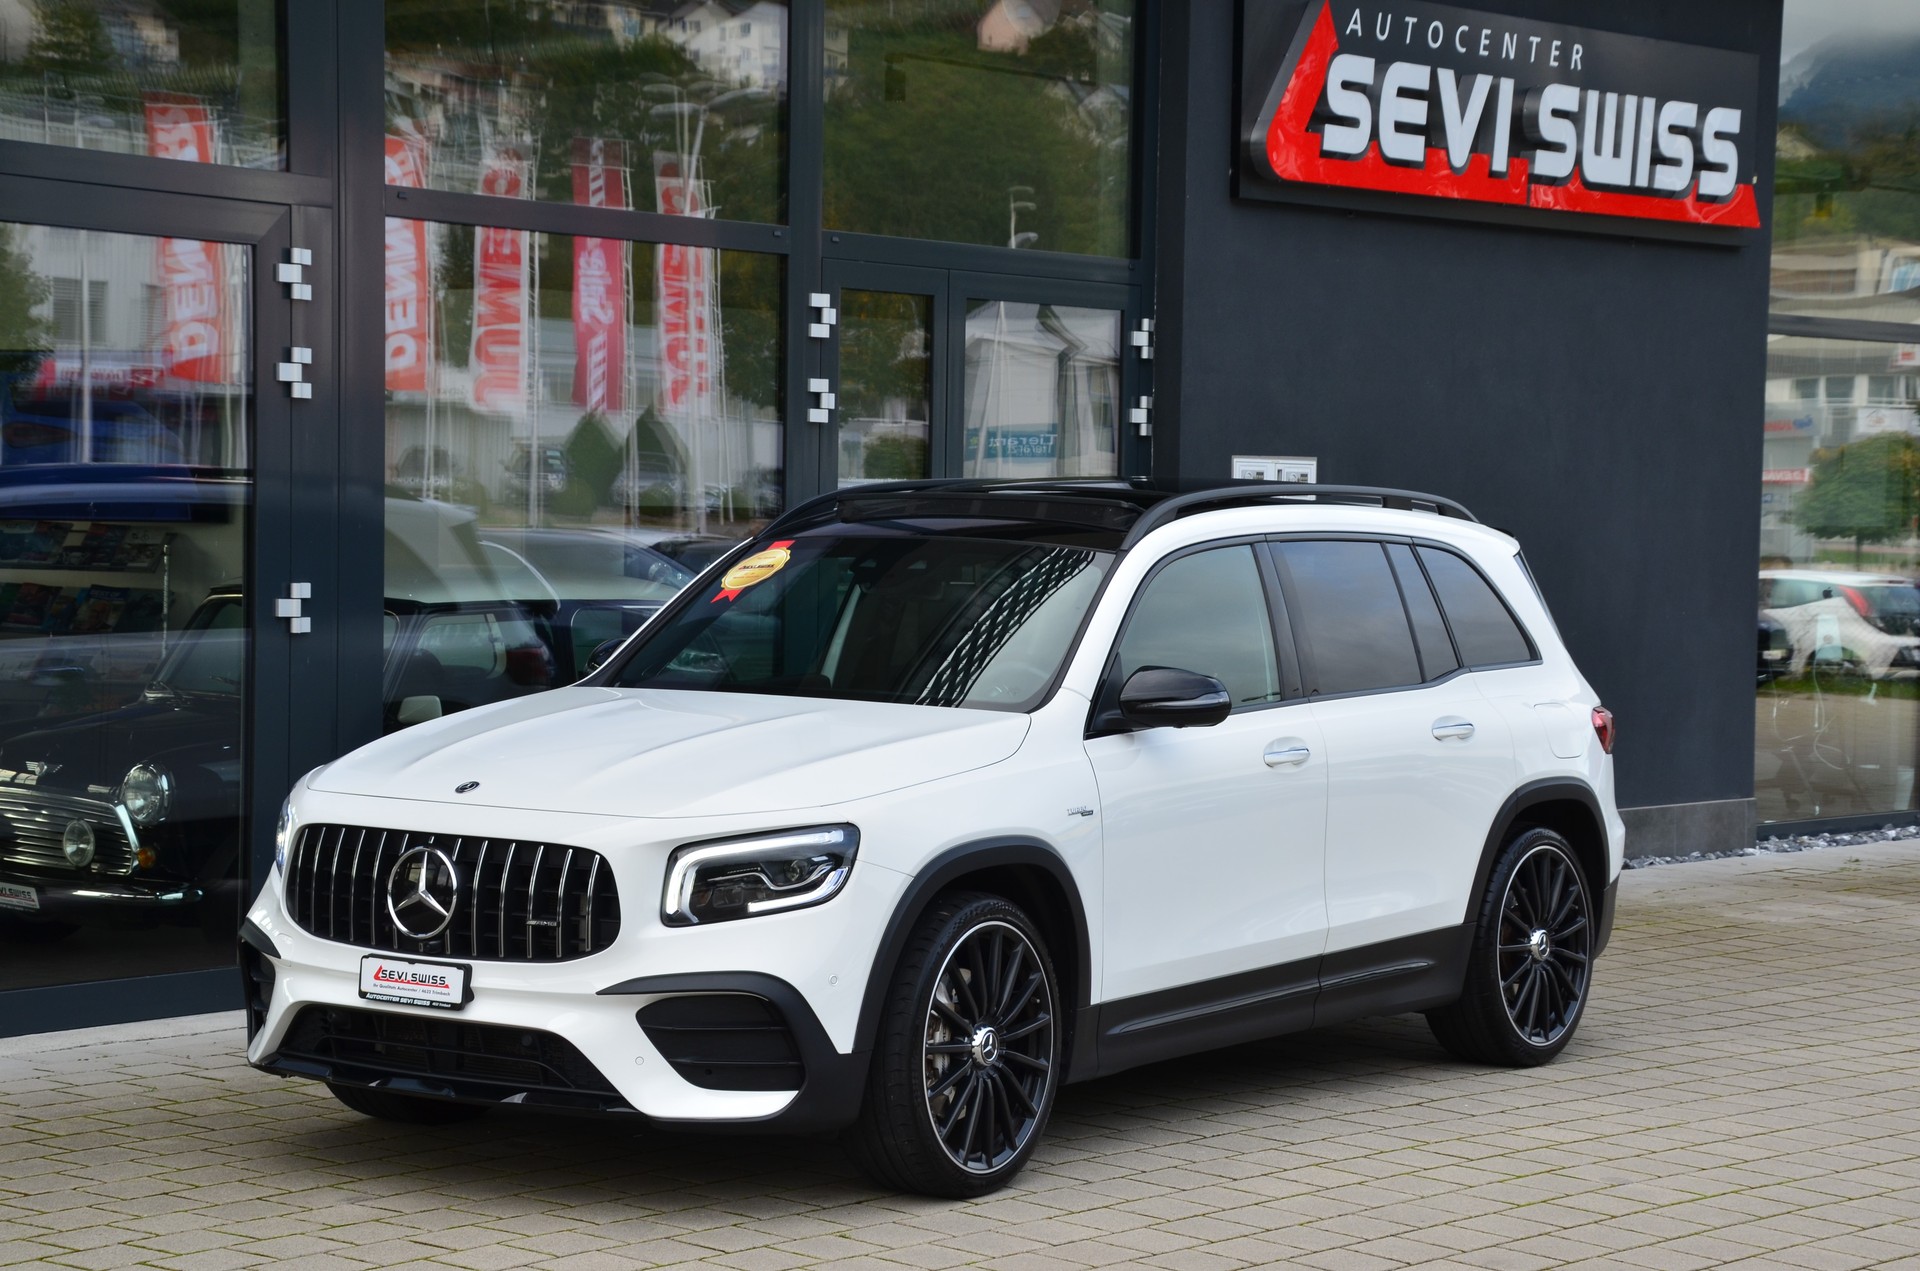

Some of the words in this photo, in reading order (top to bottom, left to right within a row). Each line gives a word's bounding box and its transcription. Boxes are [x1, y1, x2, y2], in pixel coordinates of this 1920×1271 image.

[1345, 8, 1584, 71] AUTOCENTER
[1322, 53, 1515, 173] SEVI
[1533, 83, 1742, 198] SWISS
[380, 969, 408, 981] SEVI
[411, 973, 446, 986] SWISS
